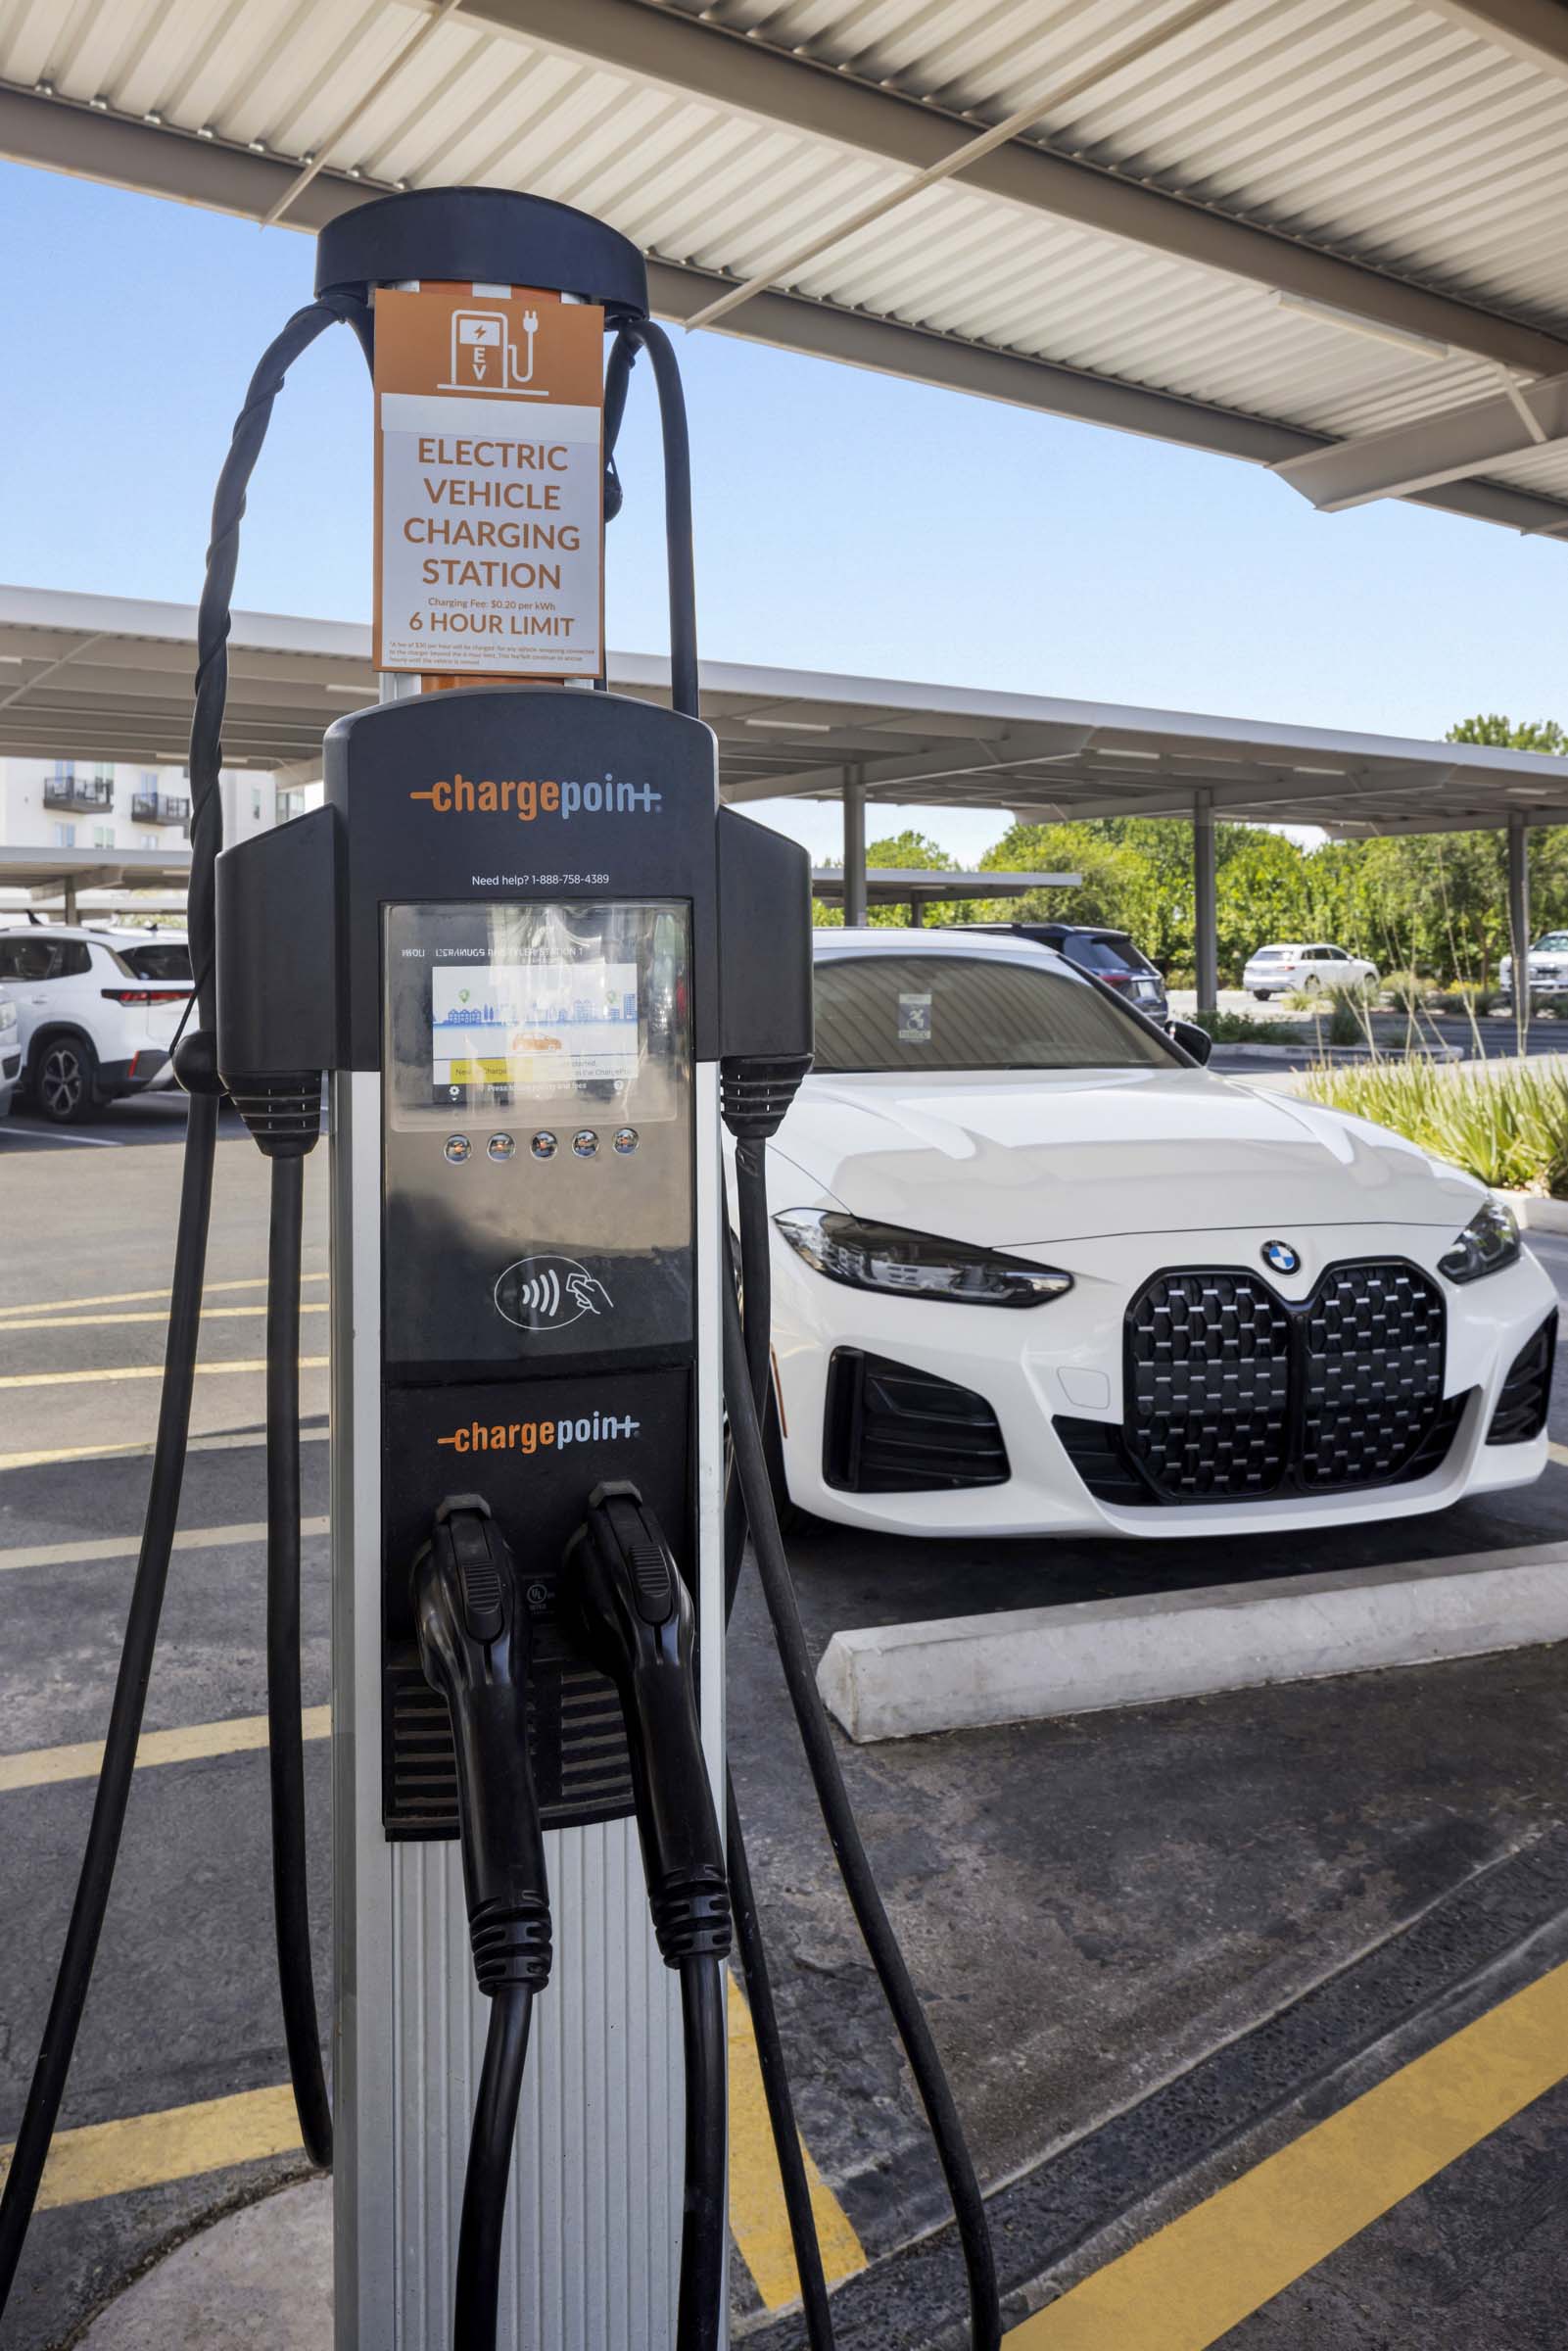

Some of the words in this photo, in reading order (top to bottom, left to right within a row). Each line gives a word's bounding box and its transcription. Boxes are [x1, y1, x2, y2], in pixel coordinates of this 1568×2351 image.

[472, 347, 487, 381] EV
[418, 438, 568, 471] ELECTRIC
[423, 477, 561, 510] VEHICLE
[404, 517, 581, 552] CHARGING
[422, 558, 561, 590] STATION
[428, 597, 467, 609] Charging
[518, 602, 533, 611] per
[535, 600, 555, 611] kWh
[408, 611, 423, 631] 6
[431, 612, 503, 634] HOUR
[510, 615, 575, 637] LIMIT
[410, 774, 662, 821] chargepoint
[472, 875, 499, 887] Need
[501, 874, 530, 887] help?
[532, 874, 610, 885] 1-888-758-4389
[437, 1411, 641, 1454] chargepoint
